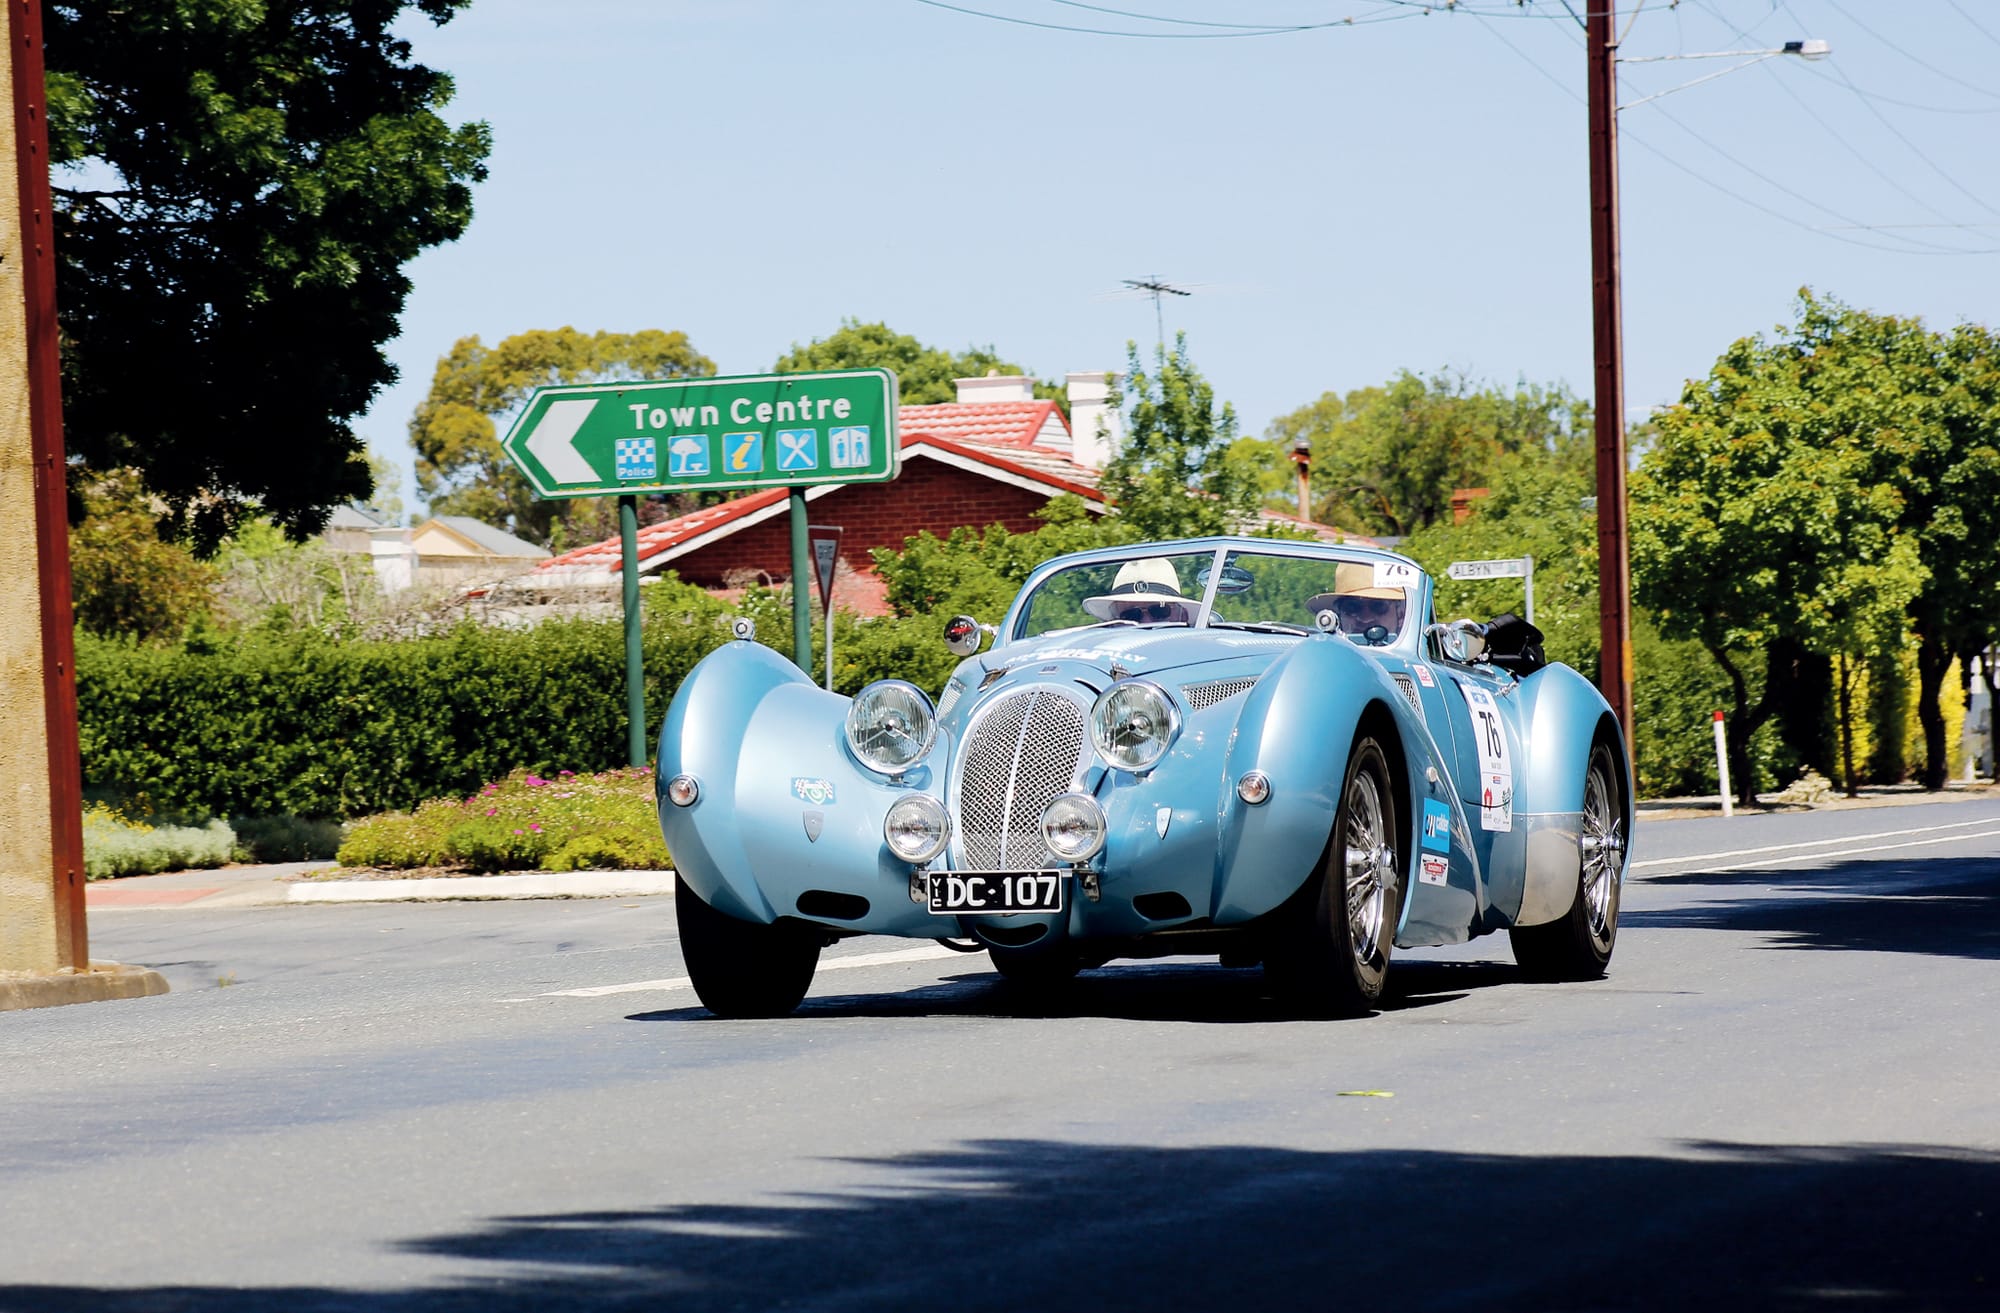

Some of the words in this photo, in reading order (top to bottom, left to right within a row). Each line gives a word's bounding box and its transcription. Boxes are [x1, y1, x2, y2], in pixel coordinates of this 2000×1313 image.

[628, 402, 719, 430] Town
[730, 395, 852, 425] Centre
[619, 467, 654, 476] Police
[1384, 563, 1409, 576] 76
[1454, 563, 1491, 577] ALBYN
[1479, 711, 1502, 759] 76
